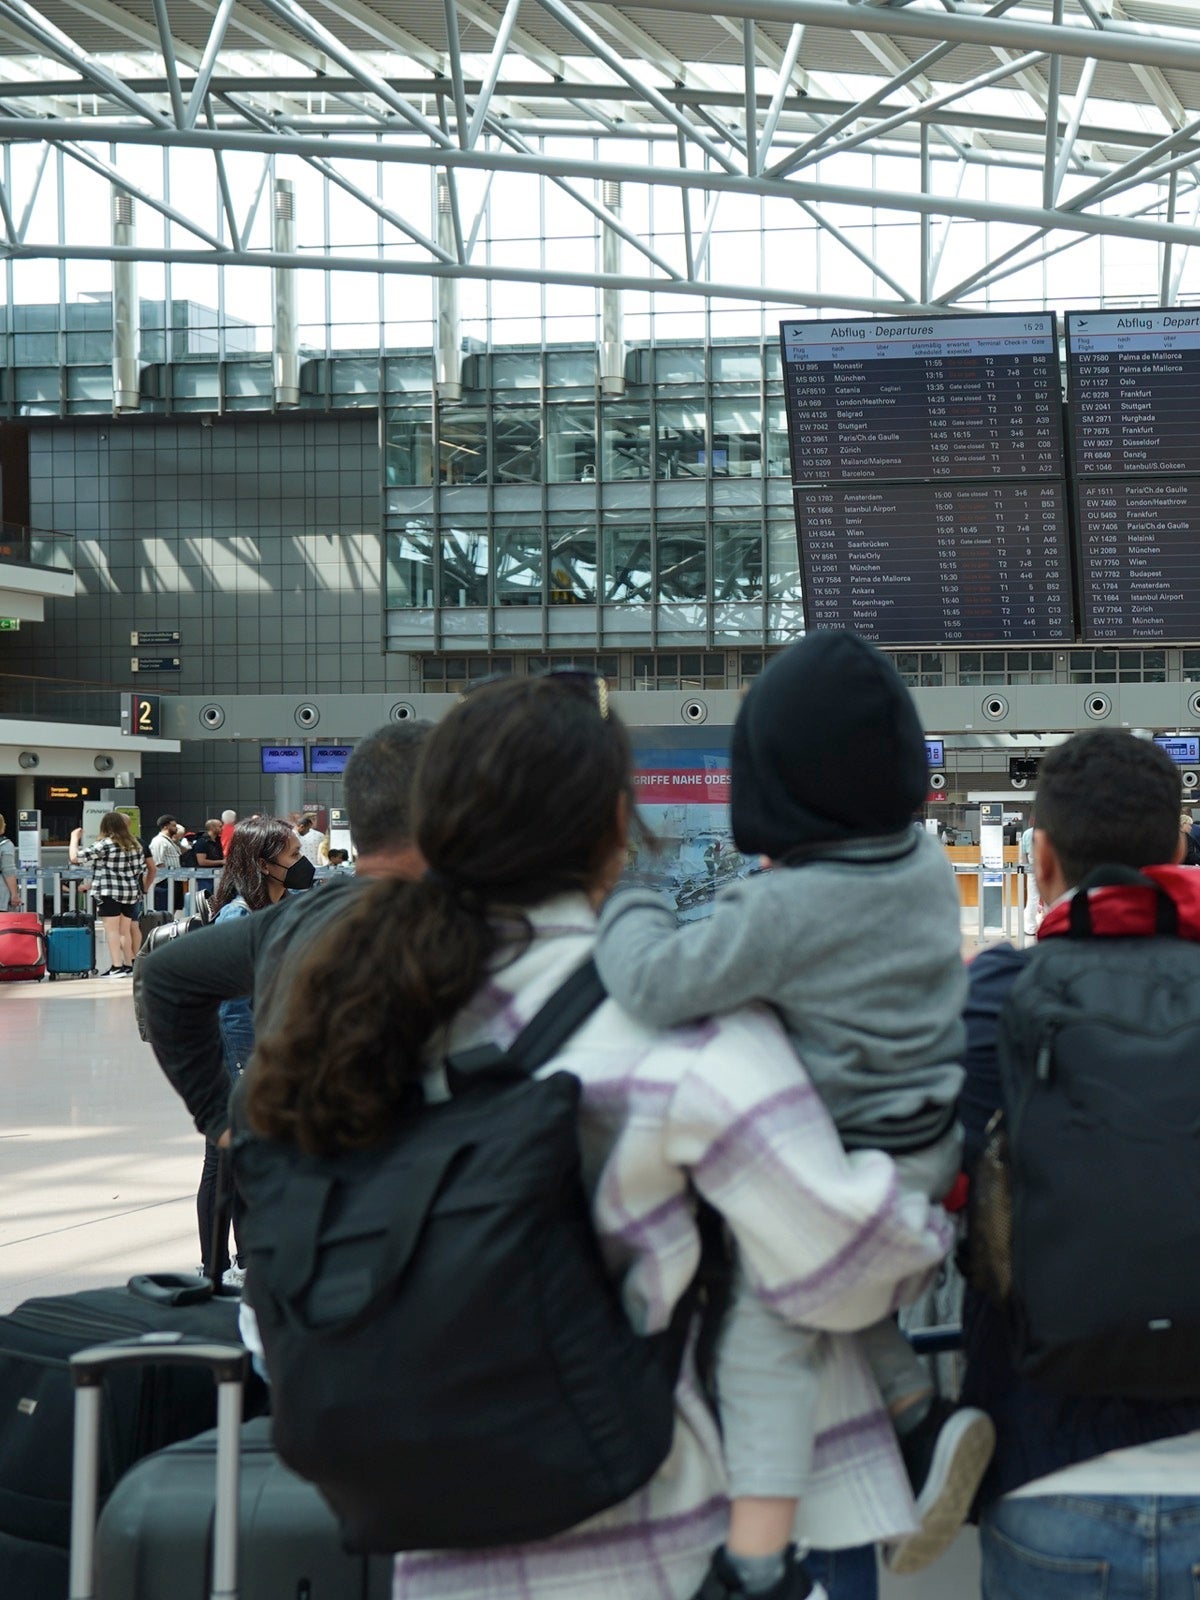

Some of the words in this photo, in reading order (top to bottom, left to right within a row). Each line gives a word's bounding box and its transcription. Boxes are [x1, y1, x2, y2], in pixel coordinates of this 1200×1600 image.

[1117, 318, 1152, 330] Abflug
[831, 327, 865, 339] Abflug
[876, 326, 933, 337] Departures
[1119, 353, 1140, 361] Palma
[833, 362, 863, 370] Monastir
[836, 398, 896, 406] London/Heathrow
[838, 423, 867, 431] Stuttgart
[1123, 438, 1160, 446] Düsseldorf
[873, 505, 896, 513] Airport
[1129, 546, 1160, 554] München
[1130, 570, 1162, 579] Budapest
[851, 576, 871, 584] Palma
[853, 599, 894, 607] Kopenhagen
[1132, 605, 1153, 613] Zürich
[140, 701, 151, 723] 2
[673, 775, 702, 784] NAHE
